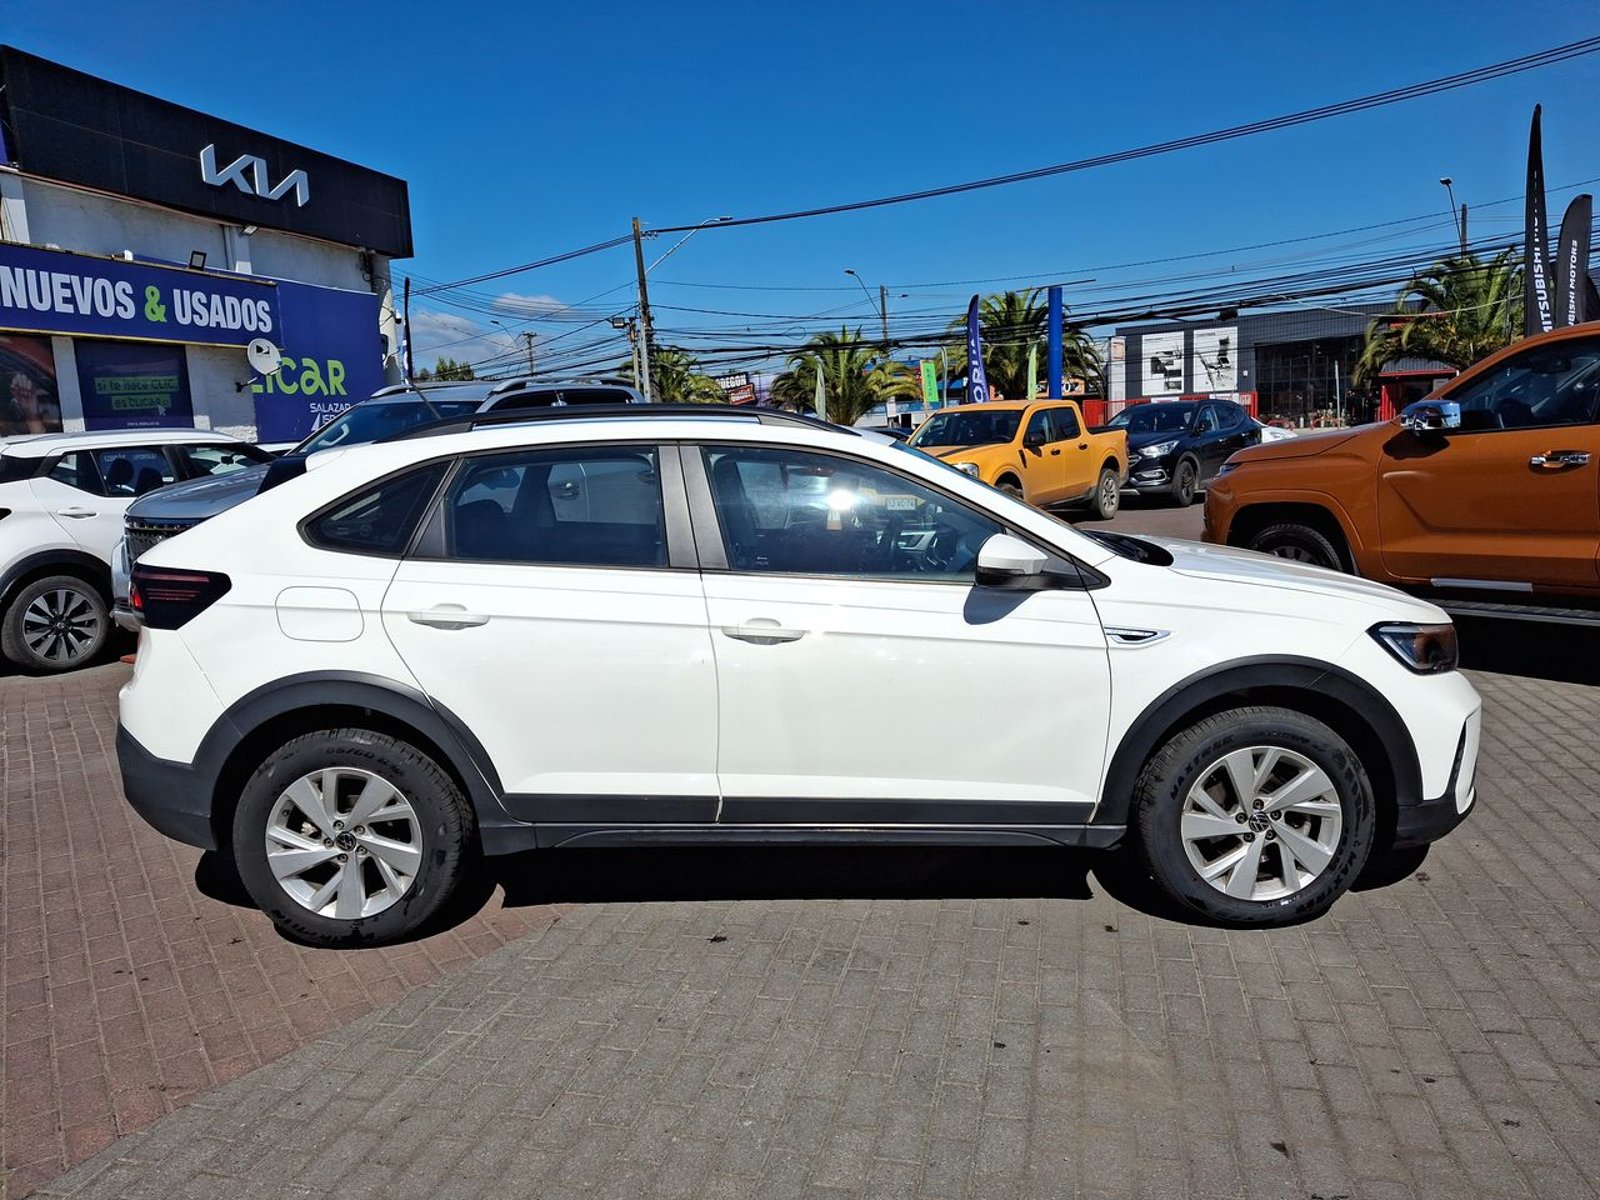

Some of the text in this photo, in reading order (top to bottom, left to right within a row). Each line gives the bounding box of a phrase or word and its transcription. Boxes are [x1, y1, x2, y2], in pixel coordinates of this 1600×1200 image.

[200, 143, 310, 207] KIA
[1569, 240, 1578, 289] MOTORS
[0, 266, 273, 334] NUEVOS & USADOS
